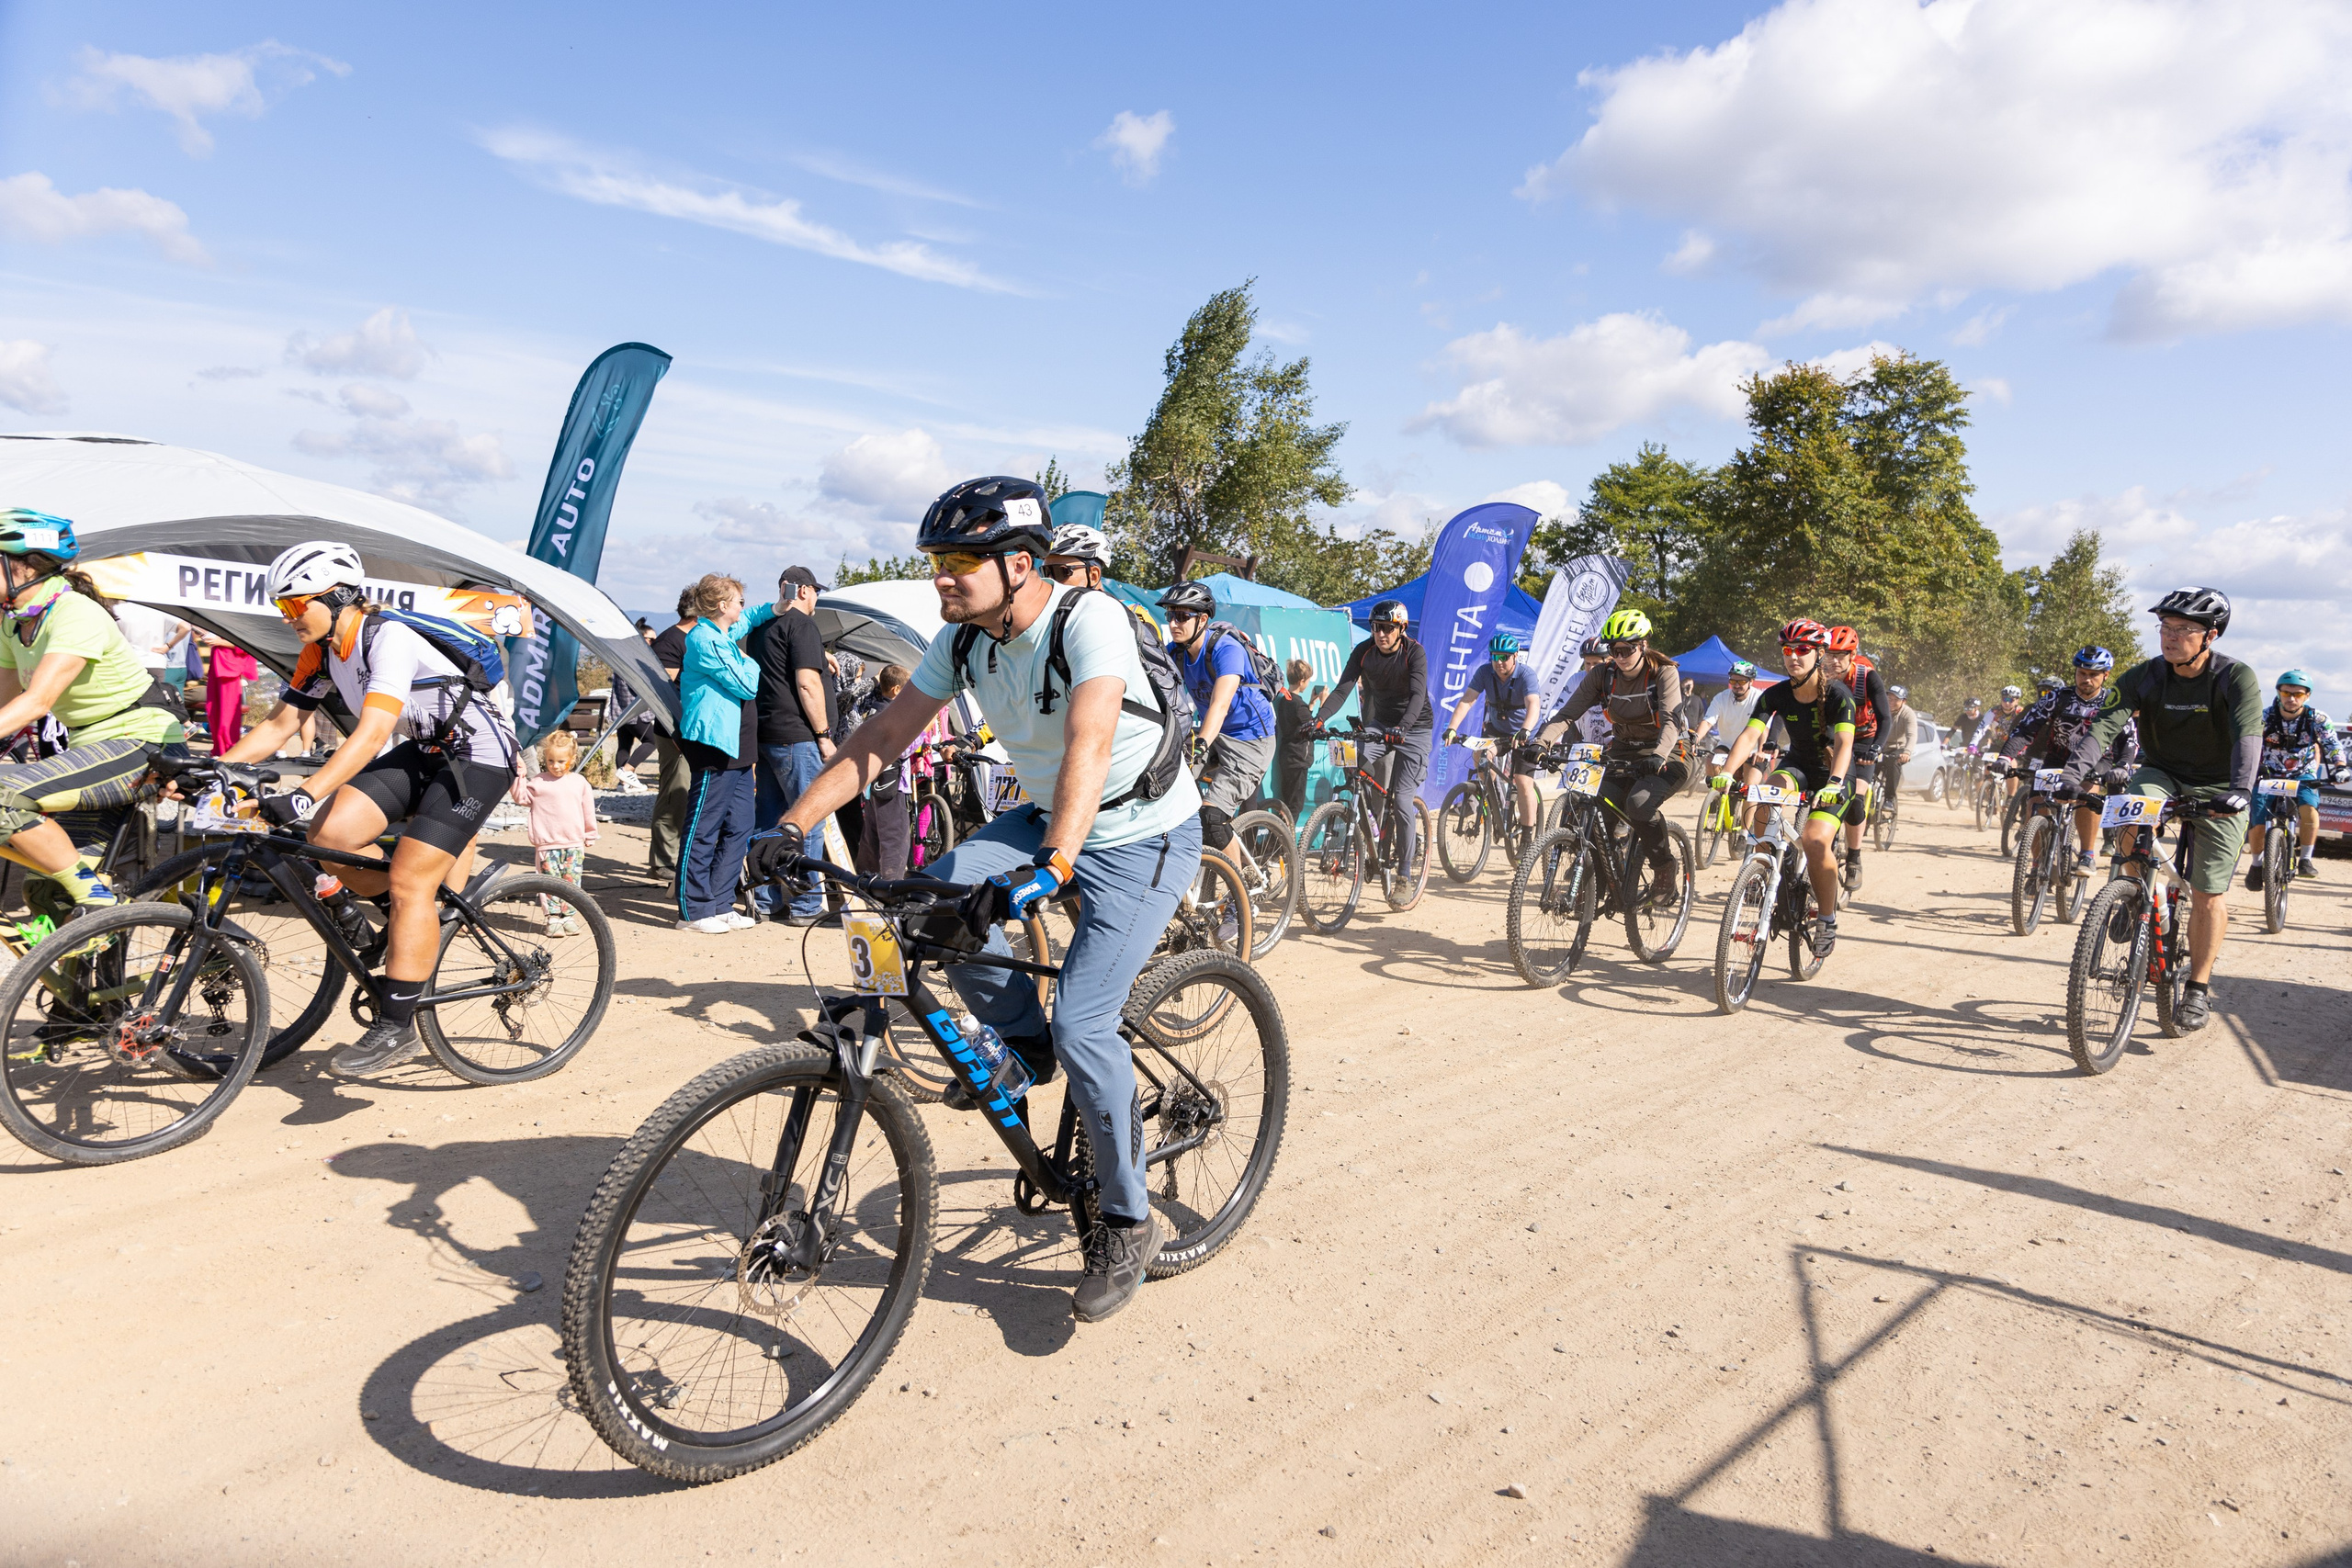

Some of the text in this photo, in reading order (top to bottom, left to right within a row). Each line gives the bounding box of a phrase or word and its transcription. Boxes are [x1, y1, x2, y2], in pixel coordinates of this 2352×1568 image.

[550, 457, 596, 558] AUTO
[1018, 504, 1033, 516] 43
[985, 523, 1009, 540] SMITH
[517, 606, 553, 731] ADMIR
[1289, 637, 1342, 684] AUTO
[1440, 604, 1487, 714] ЛЕНТА
[994, 775, 1021, 800] 777
[1569, 768, 1589, 784] 83
[2270, 781, 2286, 790] 21
[1770, 785, 1780, 795] 5
[2119, 801, 2144, 818] 68
[851, 937, 872, 978] 3
[1159, 1242, 1208, 1263] MAXXIS
[607, 1380, 669, 1451] MAXXIS
